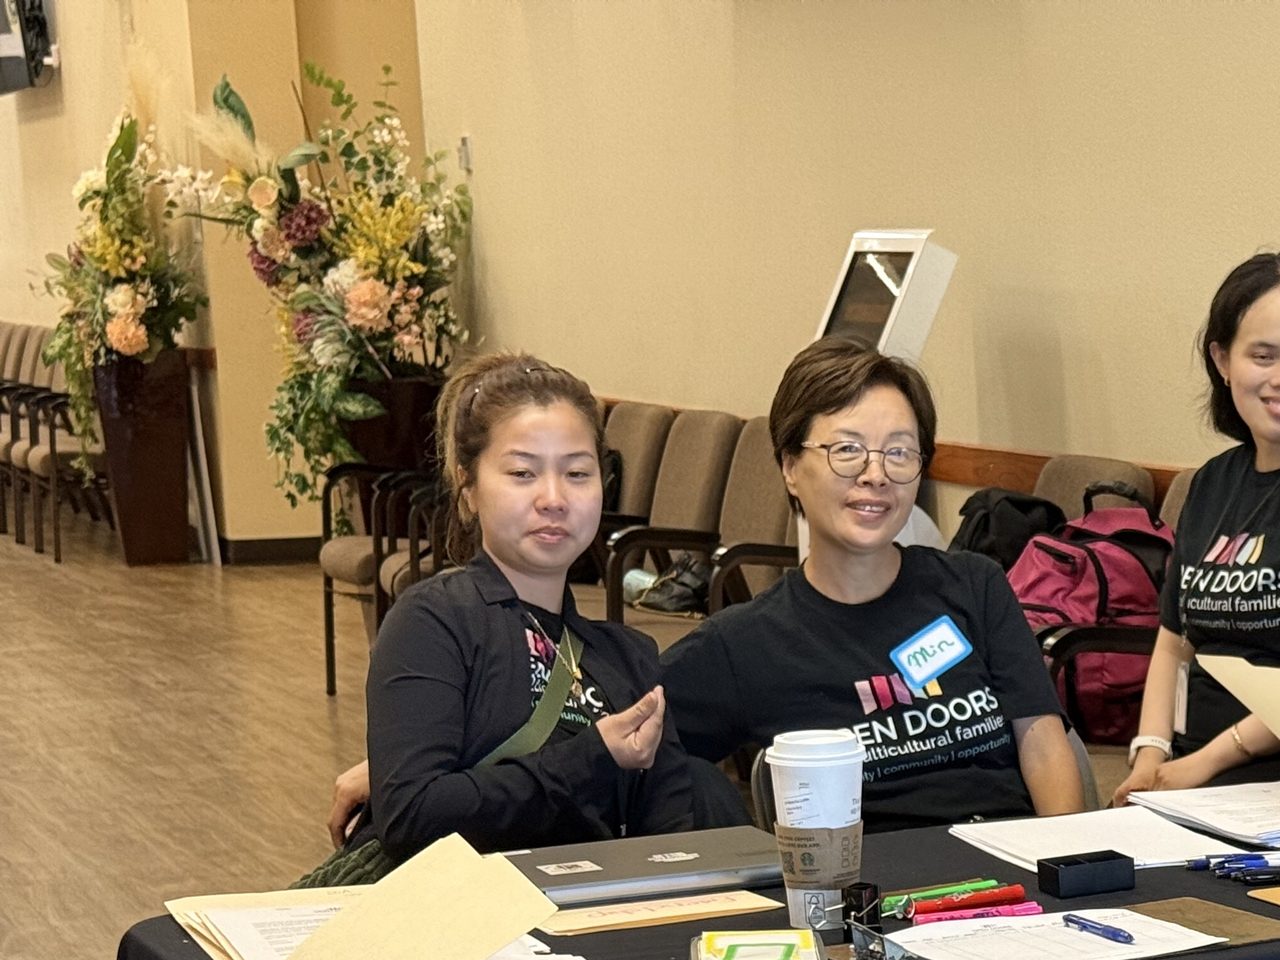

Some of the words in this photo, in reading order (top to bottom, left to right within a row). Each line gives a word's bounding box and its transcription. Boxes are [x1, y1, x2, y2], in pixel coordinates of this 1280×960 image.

[853, 716, 898, 746] EN
[902, 686, 999, 736] DOORS
[863, 729, 954, 763] ulticultural
[955, 715, 1004, 741] familie
[883, 753, 950, 775] community
